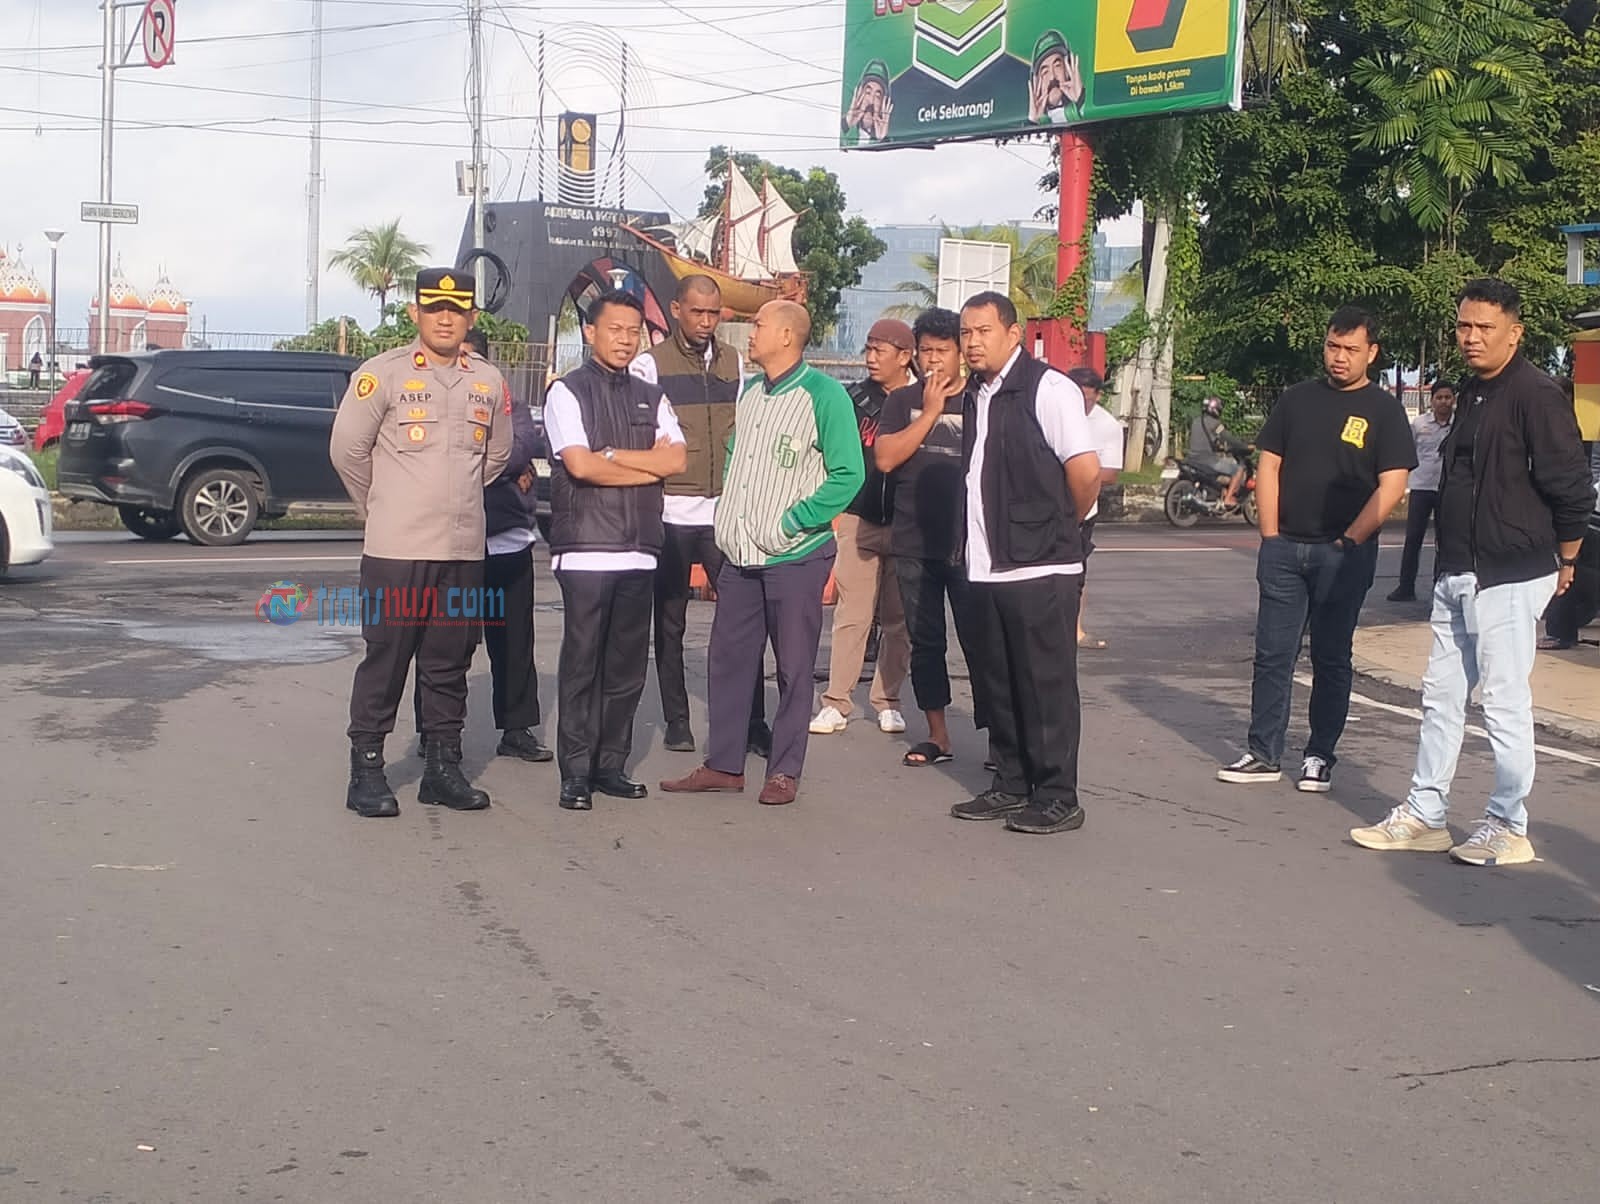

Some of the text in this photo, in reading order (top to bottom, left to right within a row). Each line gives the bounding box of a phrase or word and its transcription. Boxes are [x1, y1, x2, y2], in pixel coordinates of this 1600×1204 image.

[1126, 74, 1147, 84] Tanpa
[1166, 68, 1191, 80] promo
[1139, 83, 1163, 95] bawah
[918, 98, 994, 122] Cek Sekarang!
[400, 393, 432, 403] ASEP
